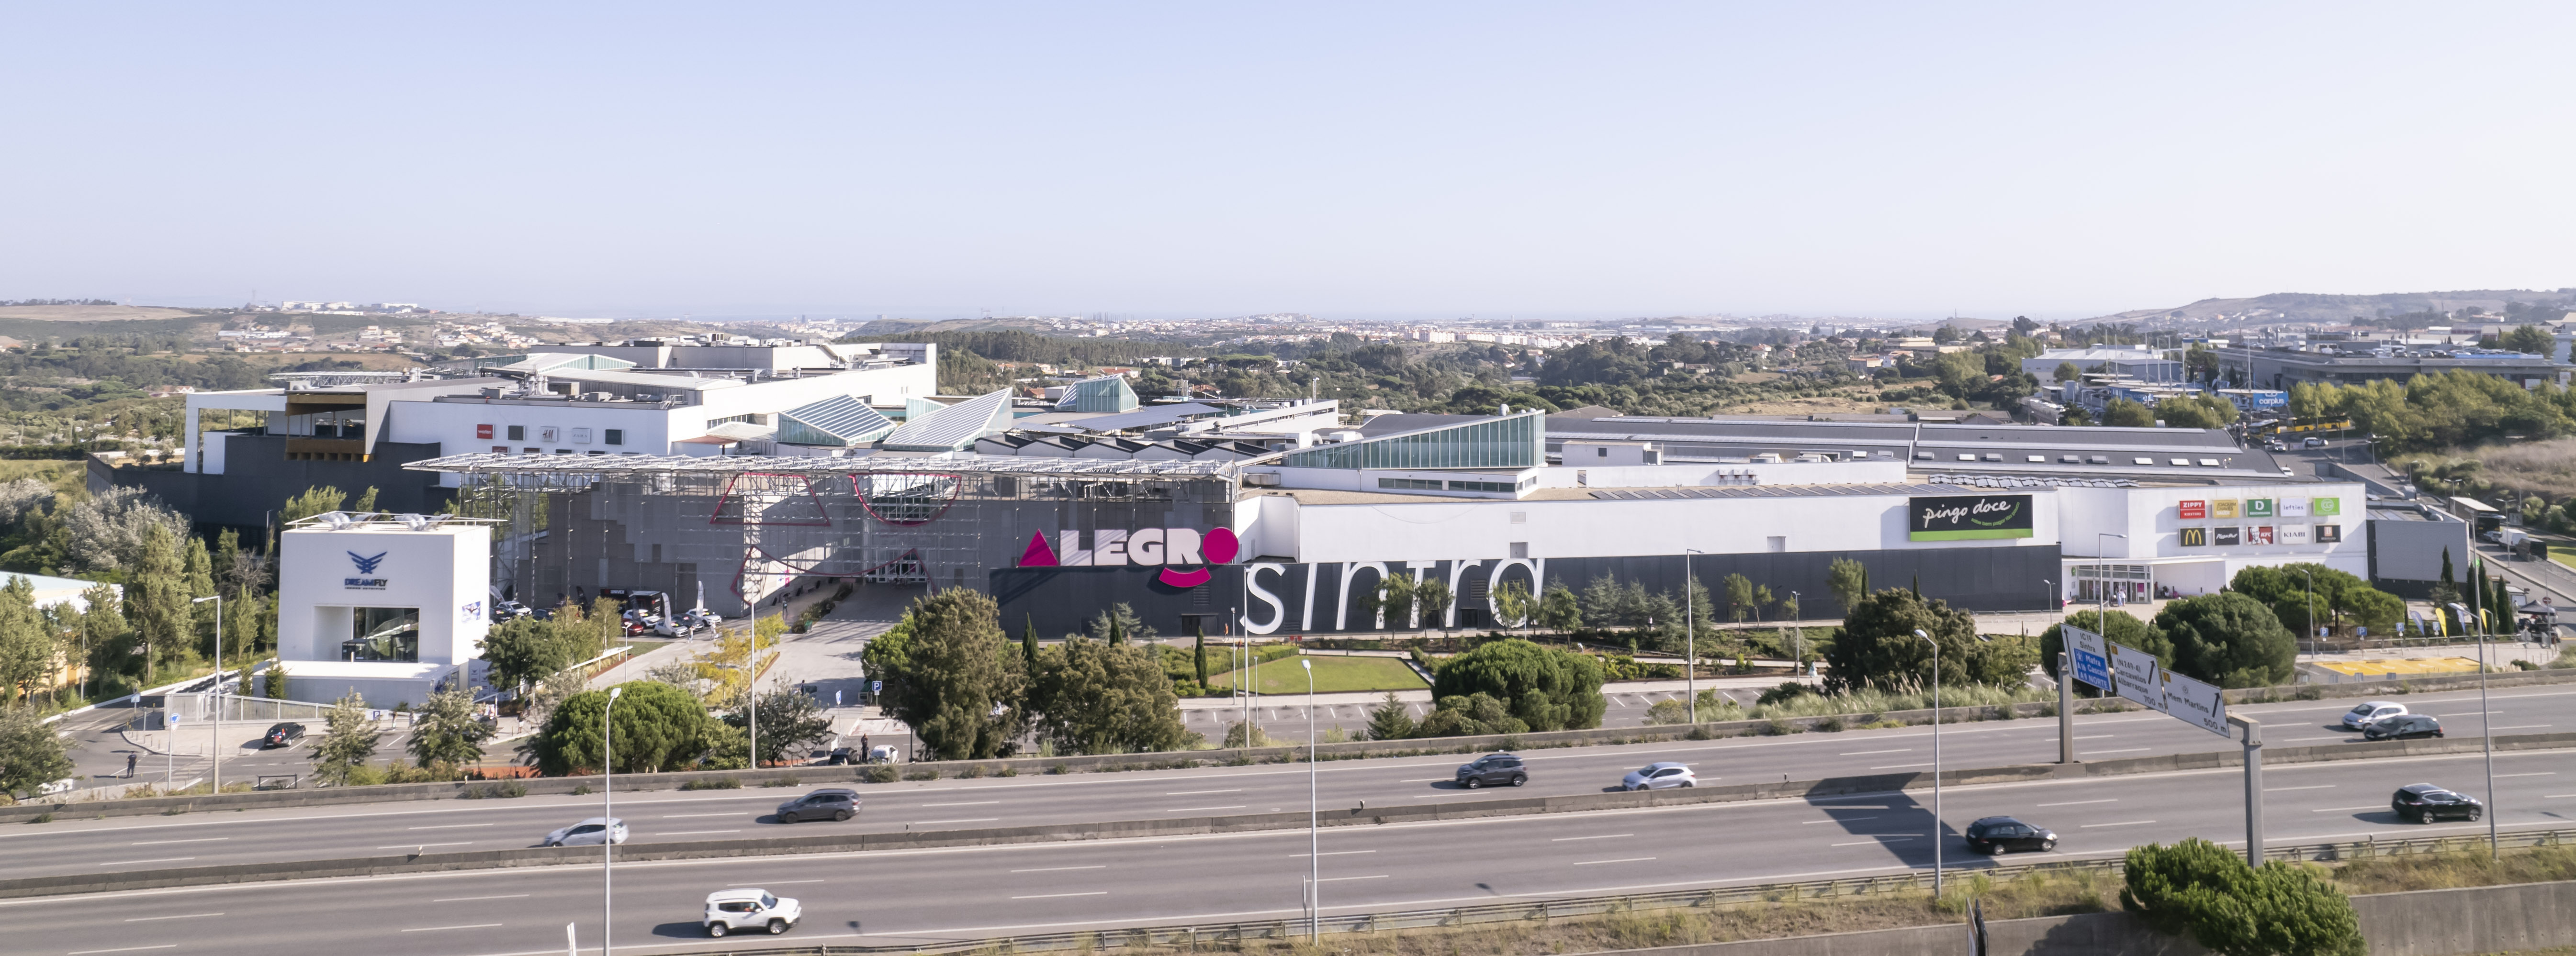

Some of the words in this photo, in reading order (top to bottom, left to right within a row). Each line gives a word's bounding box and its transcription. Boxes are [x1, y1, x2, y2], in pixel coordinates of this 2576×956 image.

[2259, 398, 2284, 406] carplus
[2255, 500, 2264, 511] D
[1923, 504, 1968, 528] pingo
[1973, 499, 2011, 514] doce
[1018, 527, 1239, 567] ALEGRO
[345, 578, 388, 587] DREAMFLY
[1240, 557, 1545, 634] sintra
[2080, 641, 2096, 653] Sintra
[2085, 655, 2101, 667] Mafra
[2087, 664, 2107, 678] Cascais
[2115, 667, 2147, 684] Carcavelos
[2088, 675, 2108, 688] NORTE
[2118, 677, 2149, 694] Albarraque
[2143, 695, 2156, 706] 700
[2168, 692, 2182, 703] Mem
[2184, 698, 2209, 713] Martins
[2204, 718, 2218, 730] 500
